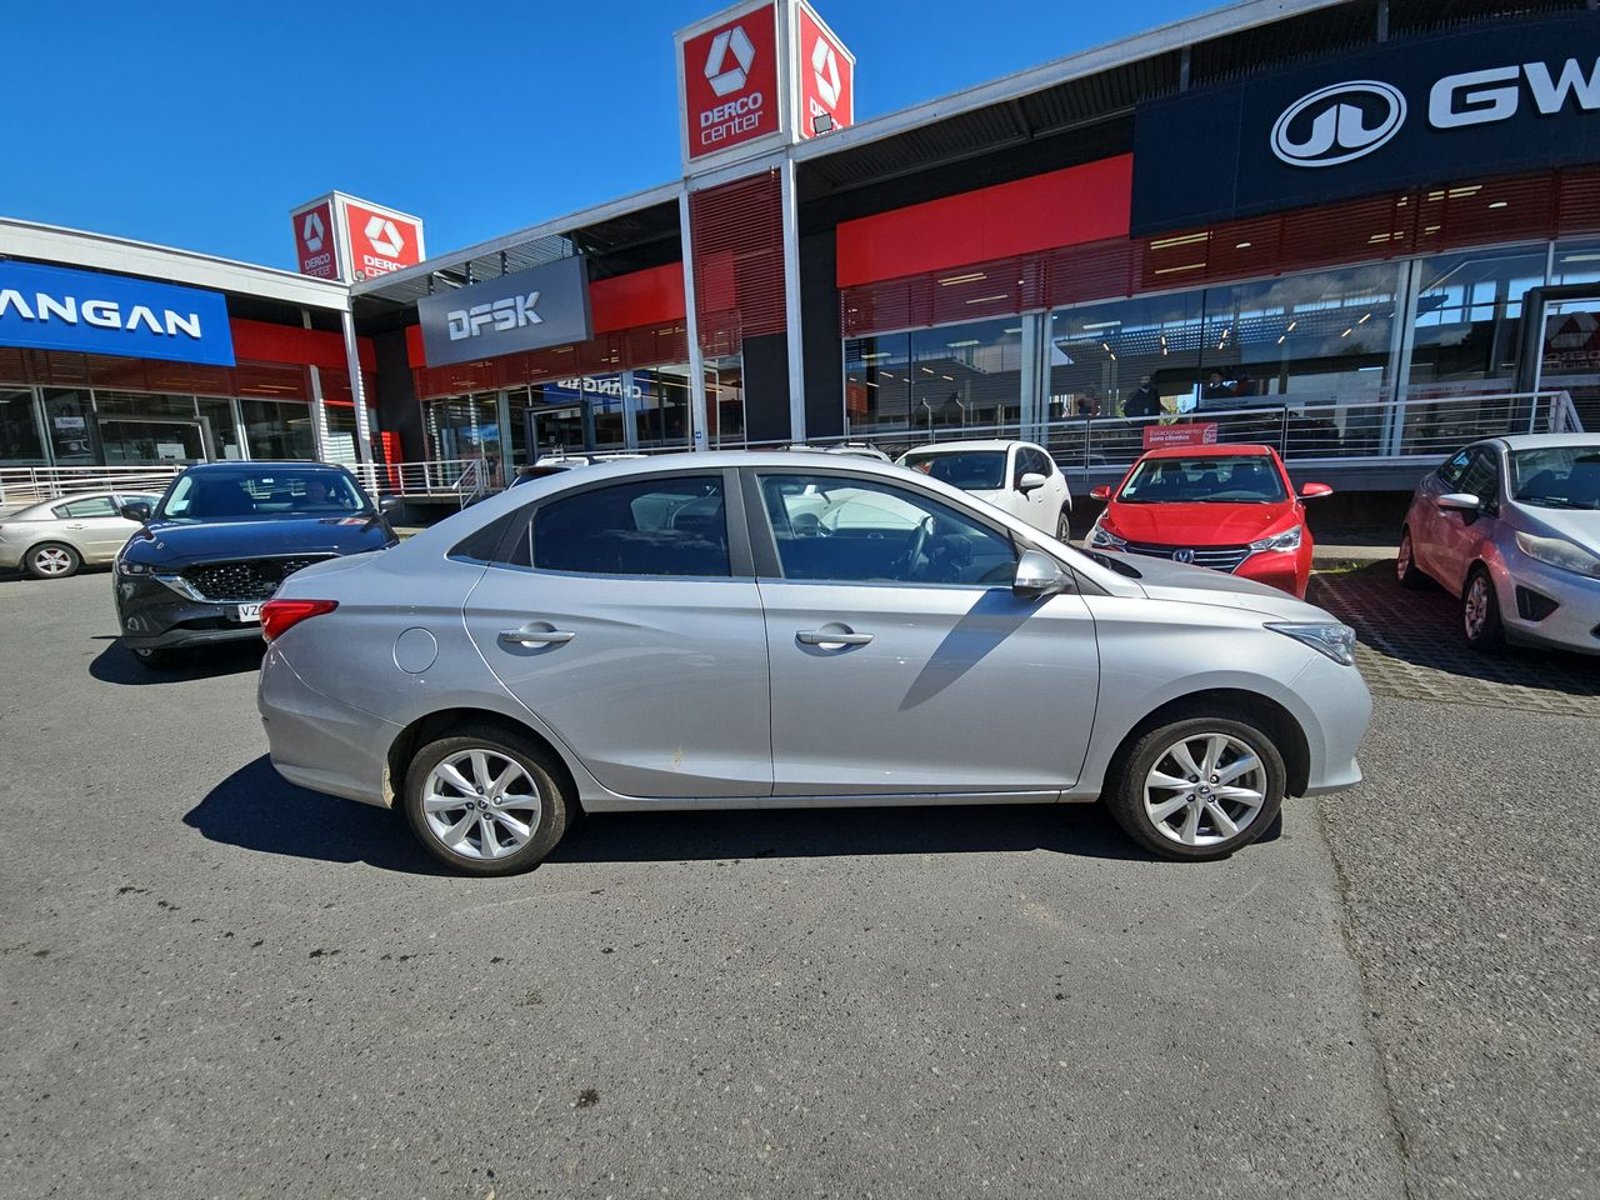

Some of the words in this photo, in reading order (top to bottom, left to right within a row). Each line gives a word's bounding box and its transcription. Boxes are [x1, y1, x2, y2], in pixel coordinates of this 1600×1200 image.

[701, 92, 762, 127] DERCO
[1429, 57, 1600, 128] GW
[702, 111, 763, 144] center
[304, 253, 330, 270] DERCO
[0, 289, 201, 338] ANGAN
[448, 291, 543, 340] DFSK
